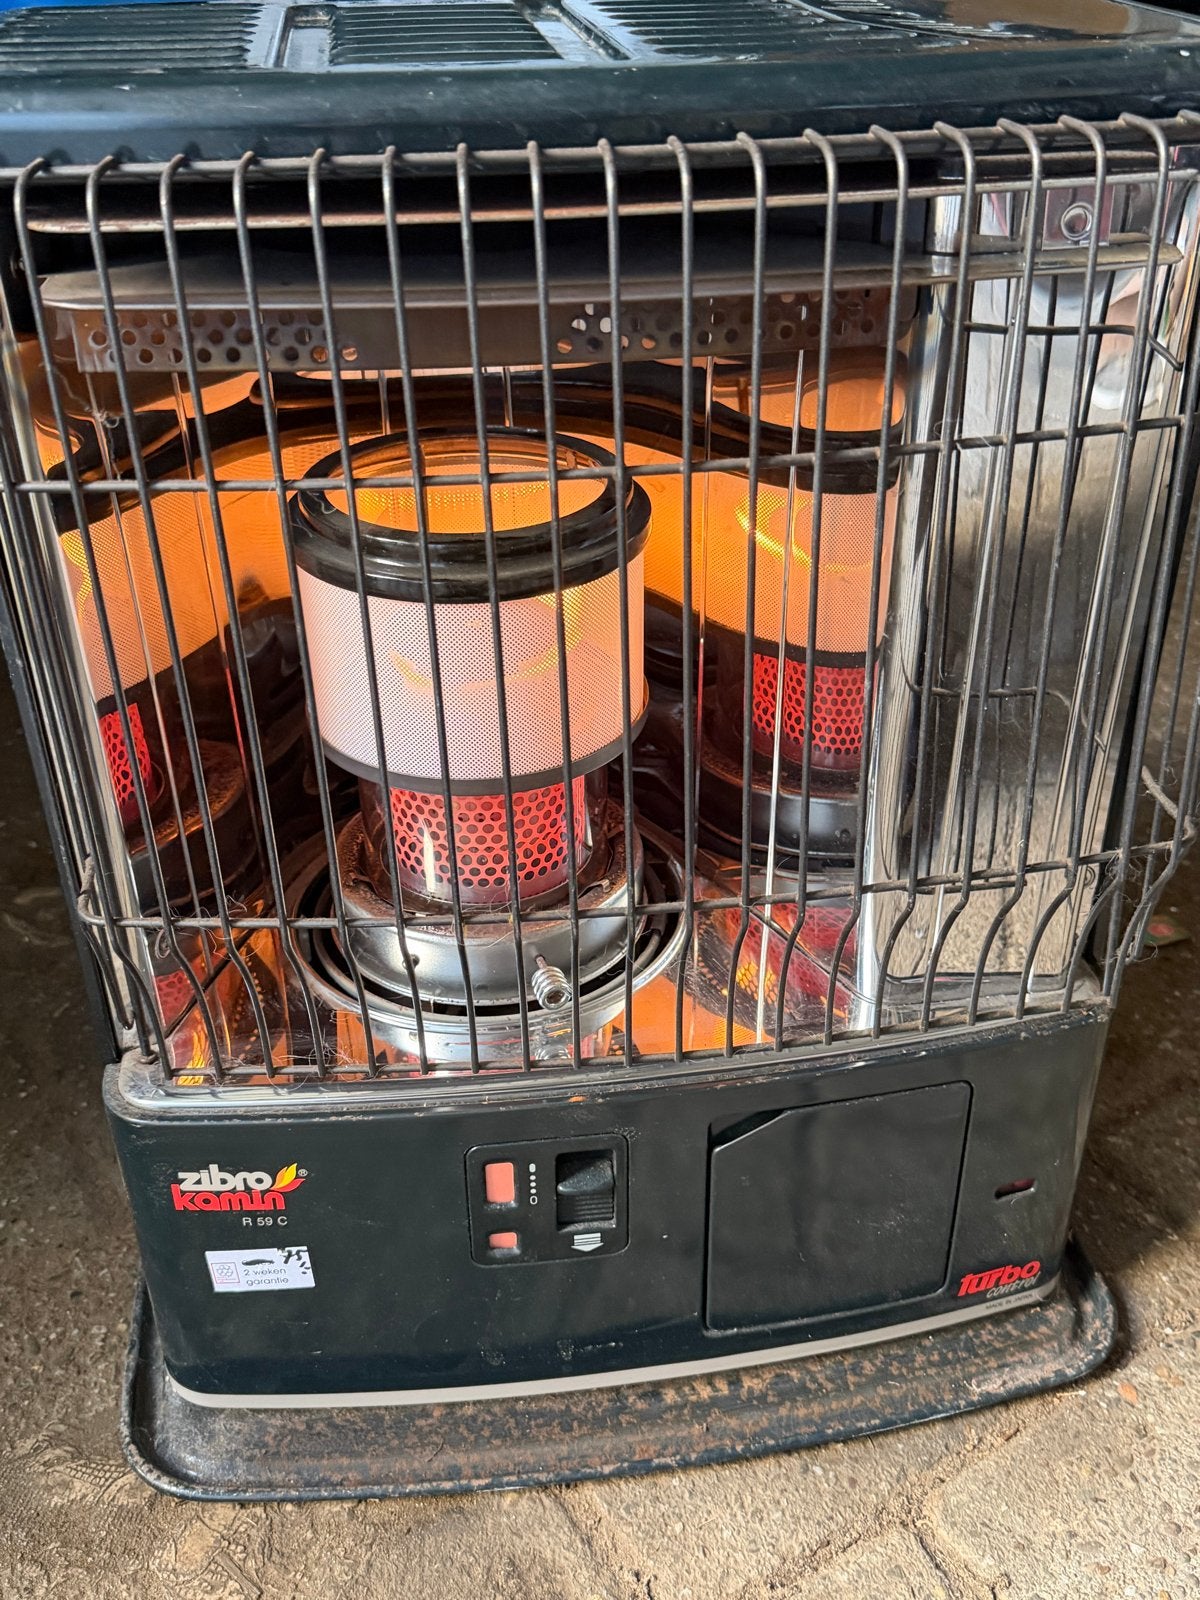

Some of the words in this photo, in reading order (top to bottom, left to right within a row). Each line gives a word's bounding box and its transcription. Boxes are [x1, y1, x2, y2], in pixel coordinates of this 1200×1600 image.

[177, 1163, 273, 1191] zibro
[170, 1184, 286, 1211] kamin
[242, 1217, 253, 1226] R
[257, 1216, 273, 1226] 59
[277, 1216, 288, 1226] C
[246, 1277, 289, 1287] garantie
[253, 1268, 287, 1276] weken
[957, 1260, 1041, 1297] turbo
[985, 1271, 1041, 1298] control
